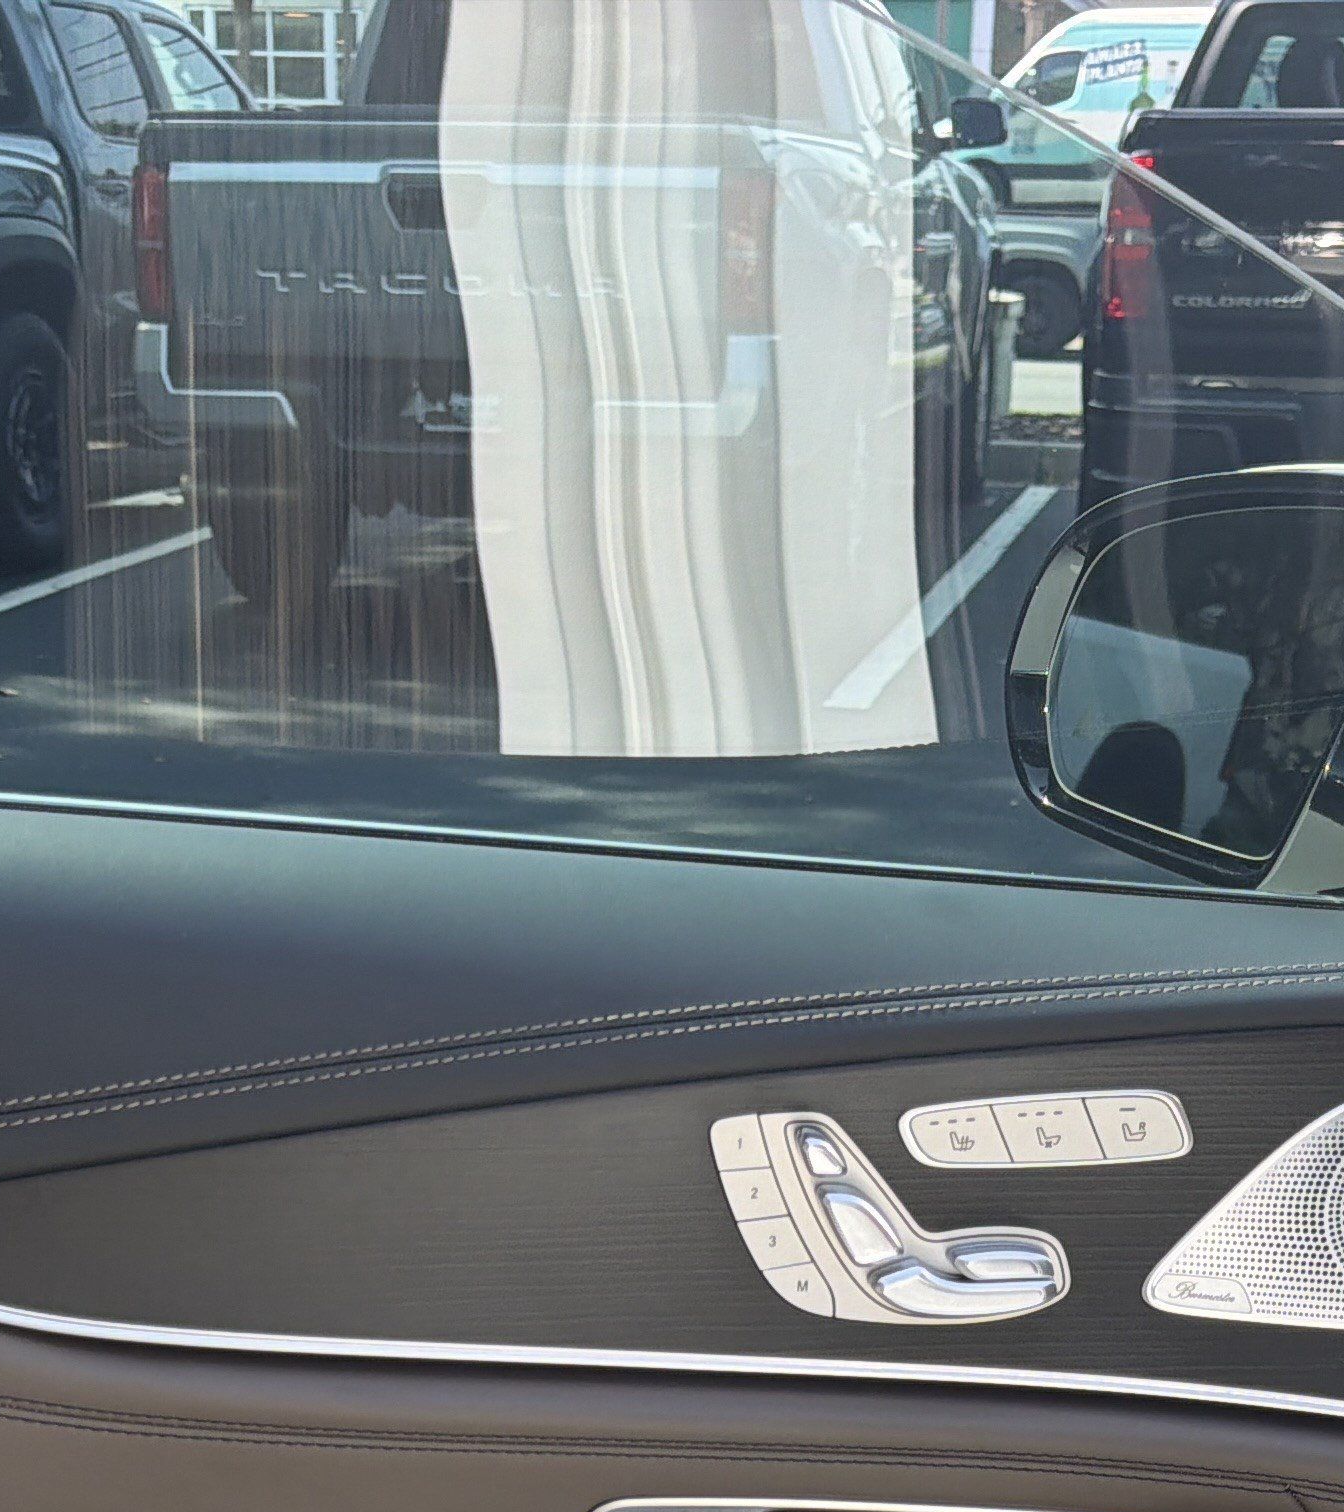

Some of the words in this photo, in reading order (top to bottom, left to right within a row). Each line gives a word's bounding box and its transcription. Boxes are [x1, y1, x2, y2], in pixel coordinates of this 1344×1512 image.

[256, 269, 626, 299] TACOMA
[737, 1137, 743, 1150] 1
[750, 1187, 759, 1200] 2
[768, 1235, 777, 1248] 3
[796, 1279, 809, 1292] M
